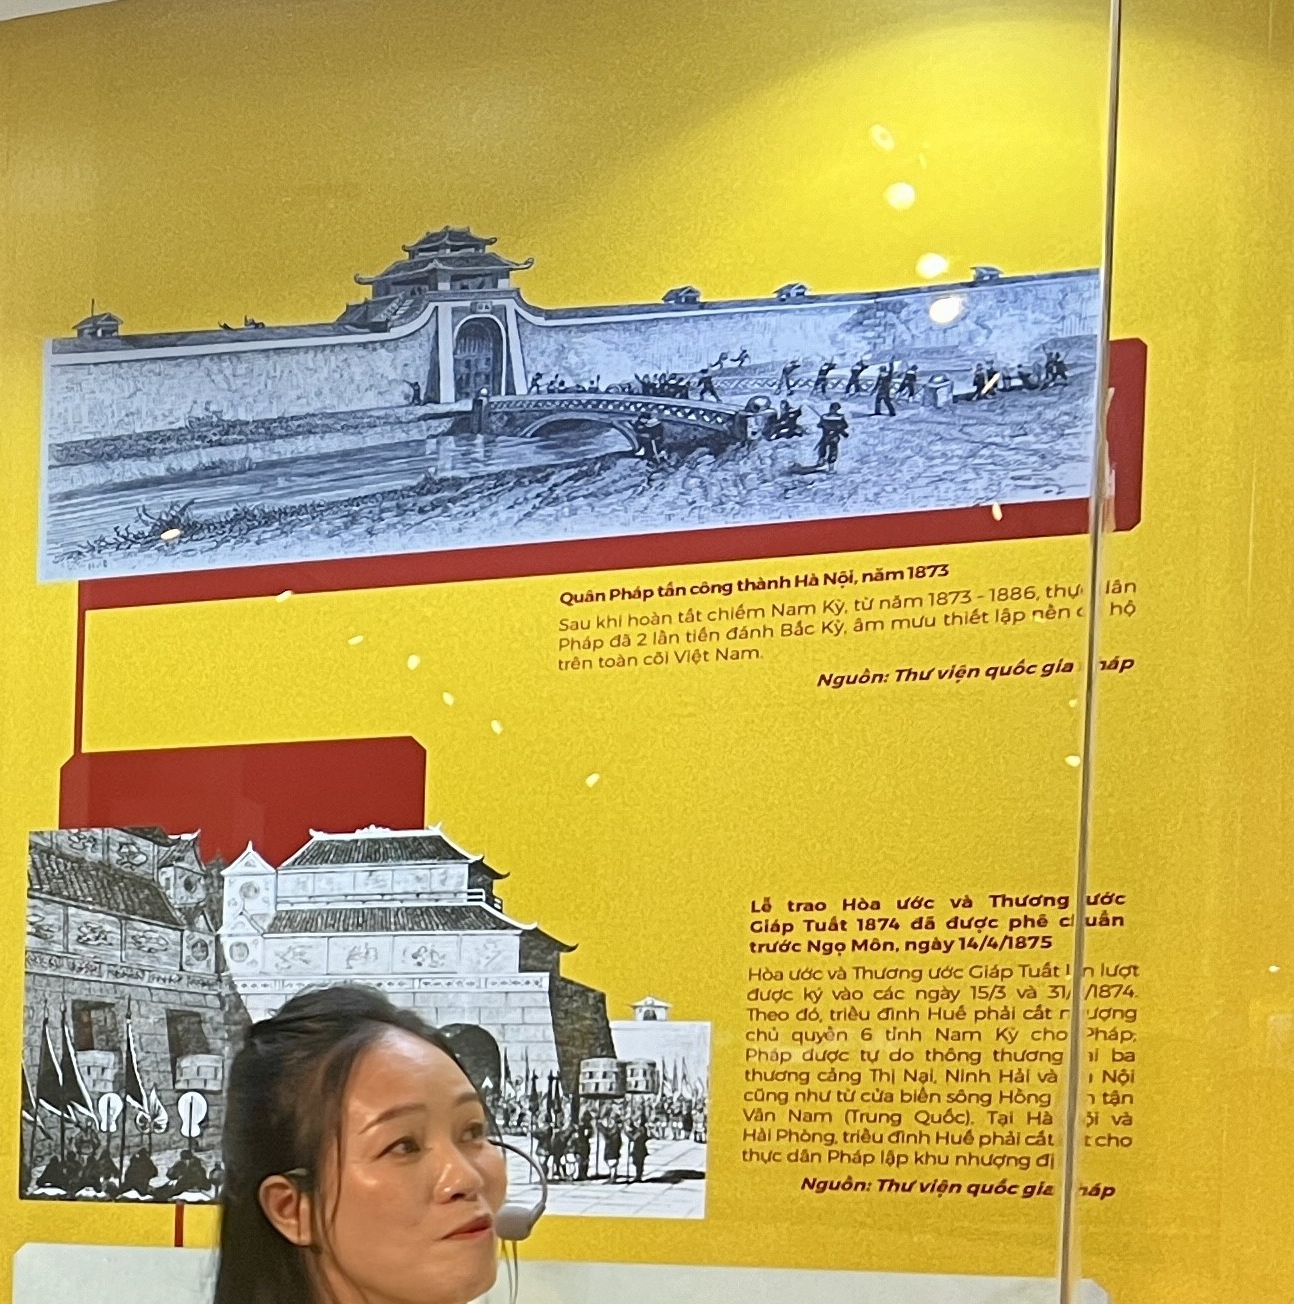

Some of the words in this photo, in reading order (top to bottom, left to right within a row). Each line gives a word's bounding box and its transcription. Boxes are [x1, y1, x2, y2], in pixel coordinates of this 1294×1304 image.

[559, 589, 606, 606] Quân
[608, 585, 654, 602] Pháp
[656, 580, 686, 597] tấn
[689, 580, 733, 596] công
[736, 574, 791, 592] thành
[794, 572, 819, 588] Hà
[861, 567, 904, 583] năm
[906, 563, 949, 579] 1873
[750, 896, 772, 913] Lễ
[786, 899, 827, 912] trao
[841, 897, 881, 911] Hòa
[896, 895, 935, 910] ước
[949, 894, 973, 909] và
[987, 893, 1069, 910] Thương
[1085, 891, 1127, 906] ước
[749, 918, 794, 936] Giáp
[802, 915, 847, 932] Tuất
[856, 917, 900, 931] 1874
[909, 915, 935, 930] đã
[945, 915, 998, 933] được
[1008, 913, 1048, 932] phê
[1058, 909, 1125, 928] cuẩn
[748, 939, 801, 953] trước
[806, 939, 846, 956] Ngọ
[904, 936, 955, 954] ngày
